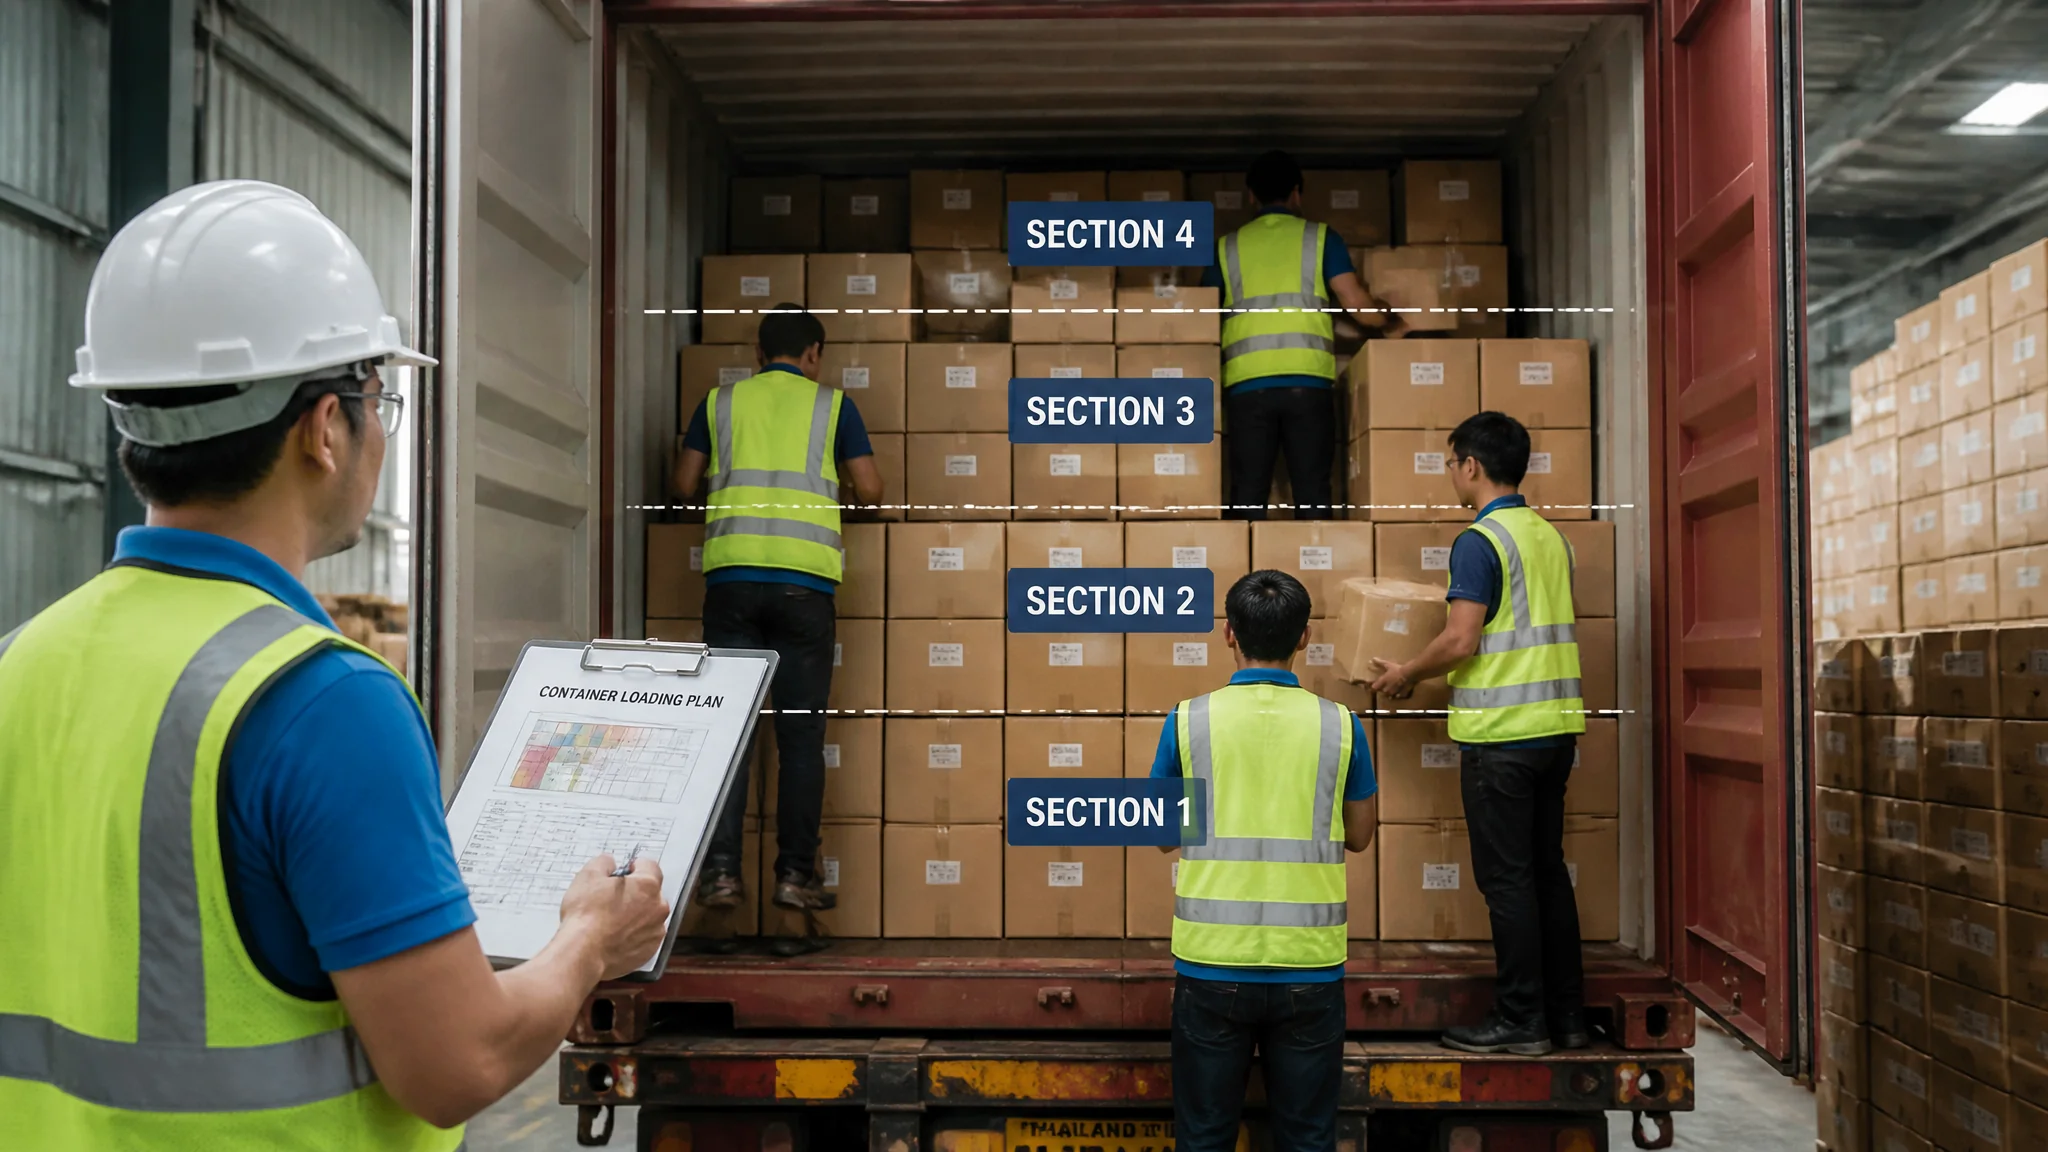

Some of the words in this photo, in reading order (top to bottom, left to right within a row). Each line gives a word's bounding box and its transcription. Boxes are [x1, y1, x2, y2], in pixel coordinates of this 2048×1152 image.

[539, 685, 618, 702] CONTAINER
[620, 691, 683, 707] LOADING
[686, 695, 724, 708] PLAN
